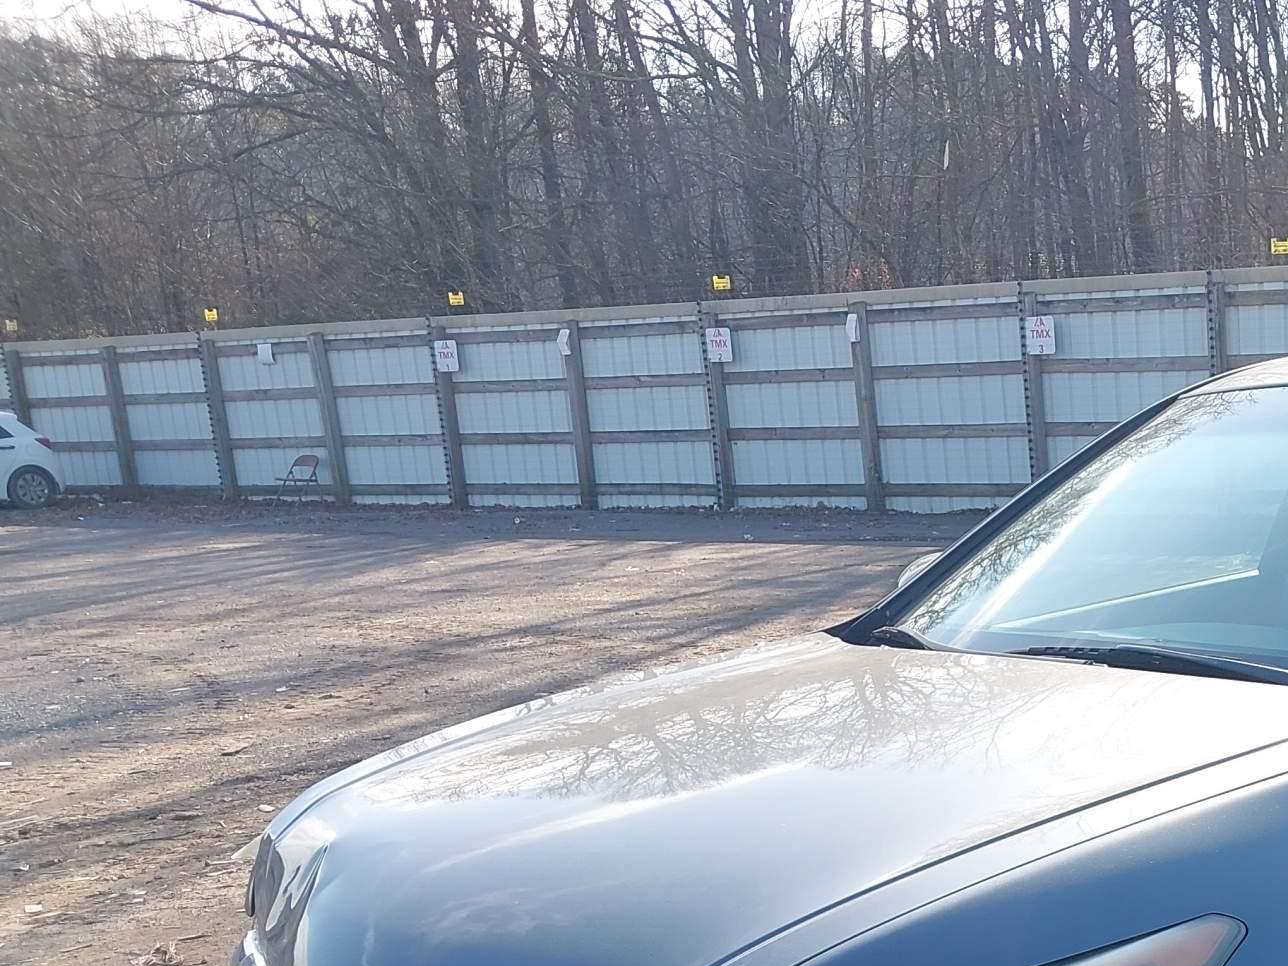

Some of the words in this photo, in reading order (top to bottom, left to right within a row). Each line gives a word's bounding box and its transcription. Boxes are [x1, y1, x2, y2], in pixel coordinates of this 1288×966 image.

[1030, 329, 1051, 339] TMX
[710, 339, 728, 348] TMX
[438, 351, 455, 360] TMX
